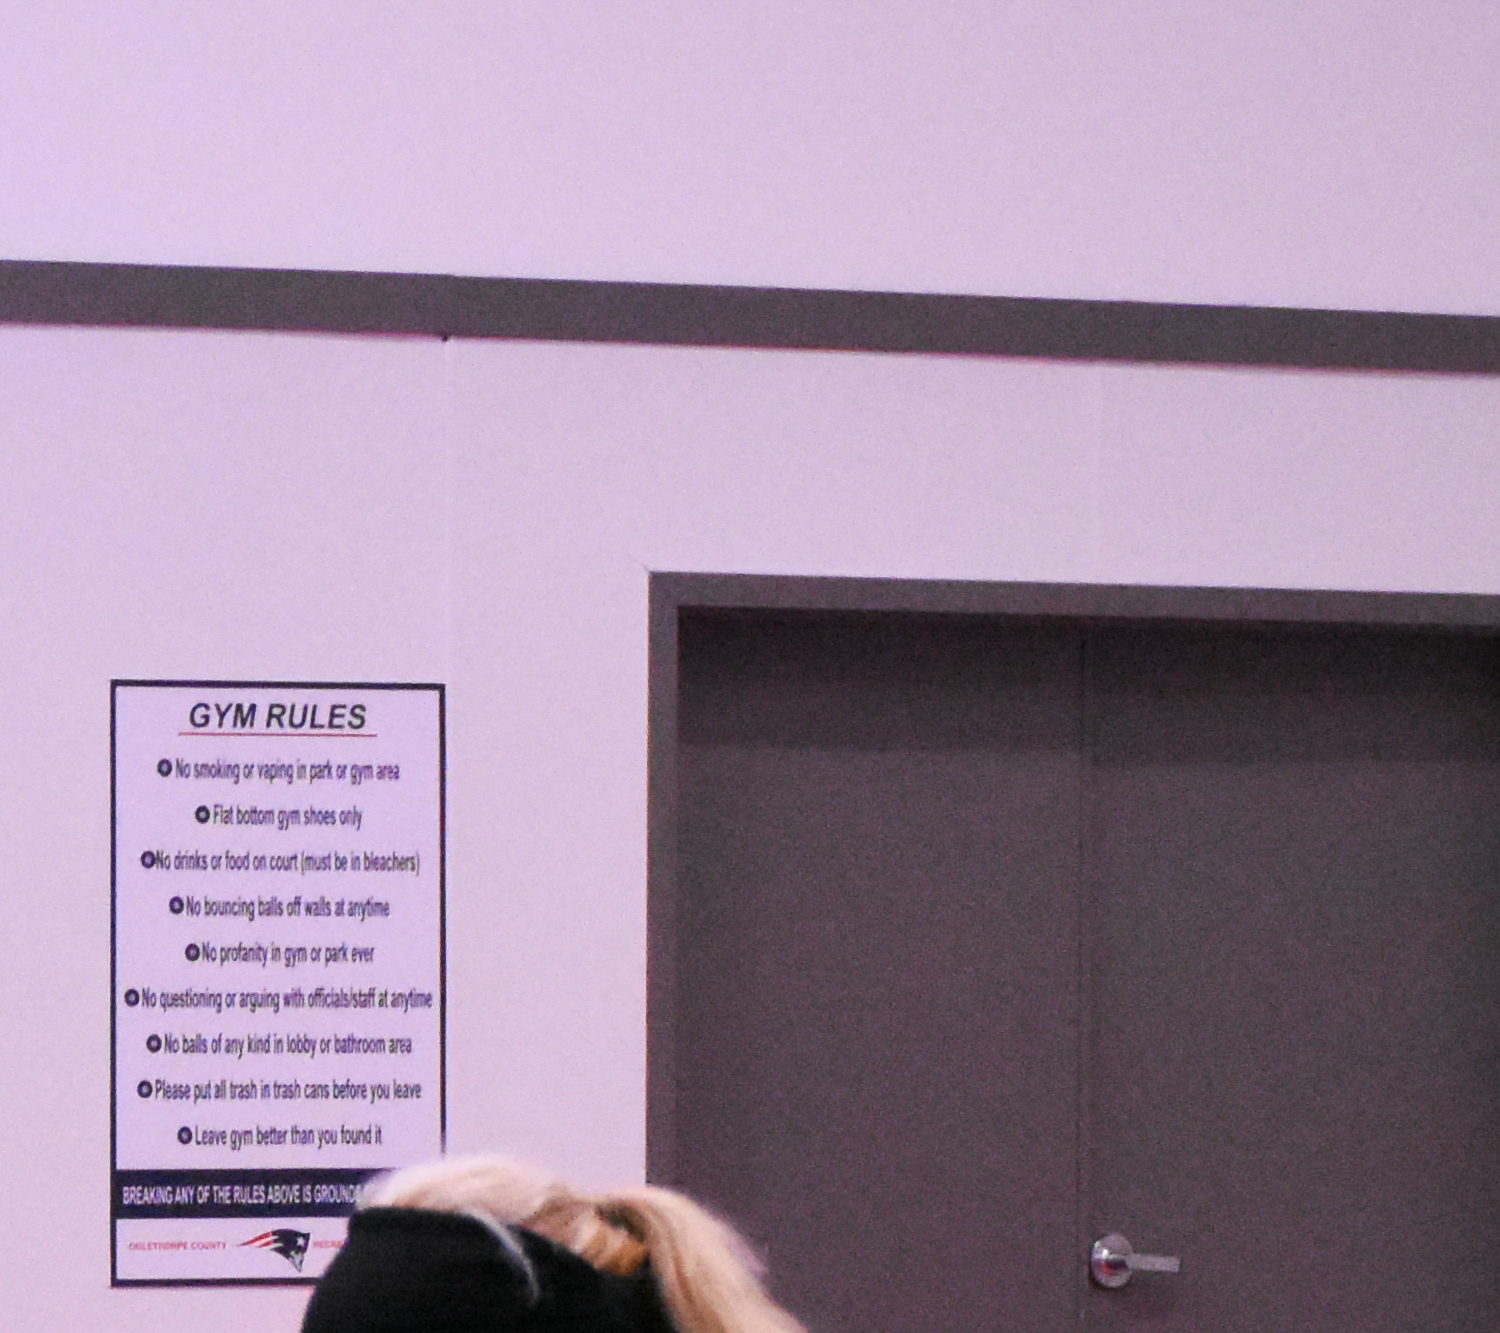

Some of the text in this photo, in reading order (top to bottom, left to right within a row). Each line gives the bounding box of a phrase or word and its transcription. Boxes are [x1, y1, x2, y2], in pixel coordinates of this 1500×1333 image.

[189, 702, 367, 730] GYM RULES
[175, 758, 400, 785] No smoking or vaping in park or gym area
[213, 804, 362, 831] Flat bottom gym shoes only
[155, 850, 420, 876] No drinks or food on court (must be in bleachers)
[186, 895, 390, 922] No bouncing balls off walls at anytime
[202, 941, 375, 968] No profanity in gym or park ever
[142, 987, 156, 1008] No
[160, 987, 222, 1013] questioning
[225, 992, 236, 1008] or
[239, 987, 280, 1013] arguing
[283, 986, 304, 1008] with
[378, 988, 388, 1009] at
[391, 987, 432, 1013] anytime
[164, 1033, 412, 1060] No balls of any kind in lobby or bathroom area
[155, 1079, 421, 1104] Please put all trash in trash cans before you leave
[195, 1125, 382, 1151] Leave gym better than you found it
[122, 1186, 173, 1205] BREAKING
[175, 1186, 194, 1204] ANY
[197, 1185, 210, 1204] OF
[212, 1185, 231, 1204] THE
[233, 1185, 265, 1204] RULES
[267, 1185, 300, 1204] ABOVE
[302, 1184, 312, 1203] IS
[190, 1241, 228, 1250] COUNTY
